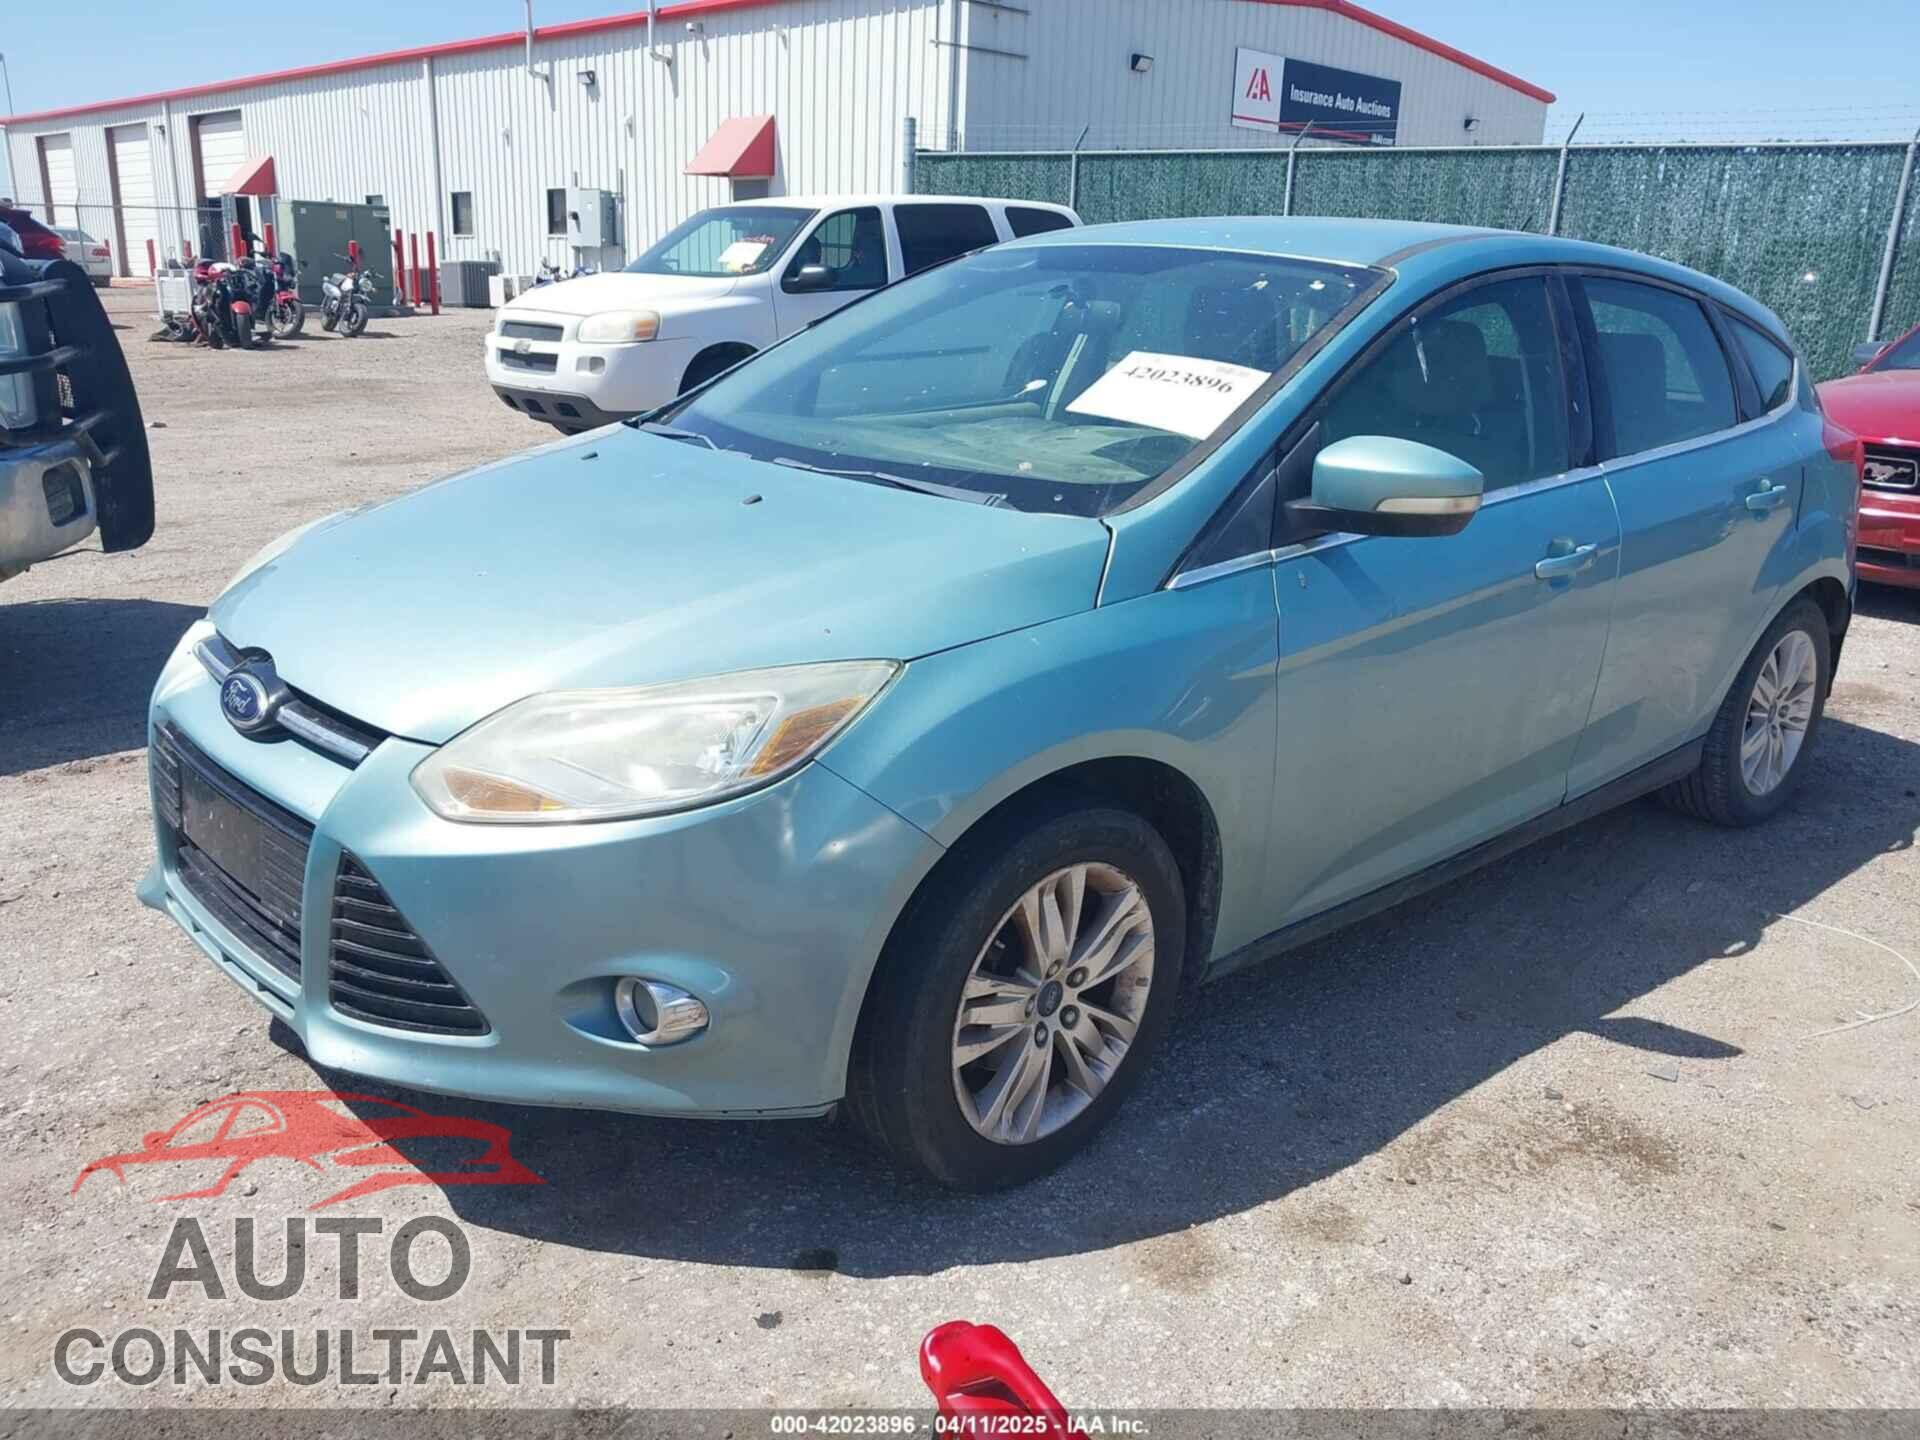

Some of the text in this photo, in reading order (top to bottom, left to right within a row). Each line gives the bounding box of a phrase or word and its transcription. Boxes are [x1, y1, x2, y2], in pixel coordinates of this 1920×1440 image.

[1290, 83, 1391, 118] Insurance Auto Auctions
[1123, 366, 1233, 393] 42023896
[224, 680, 252, 714] Ford
